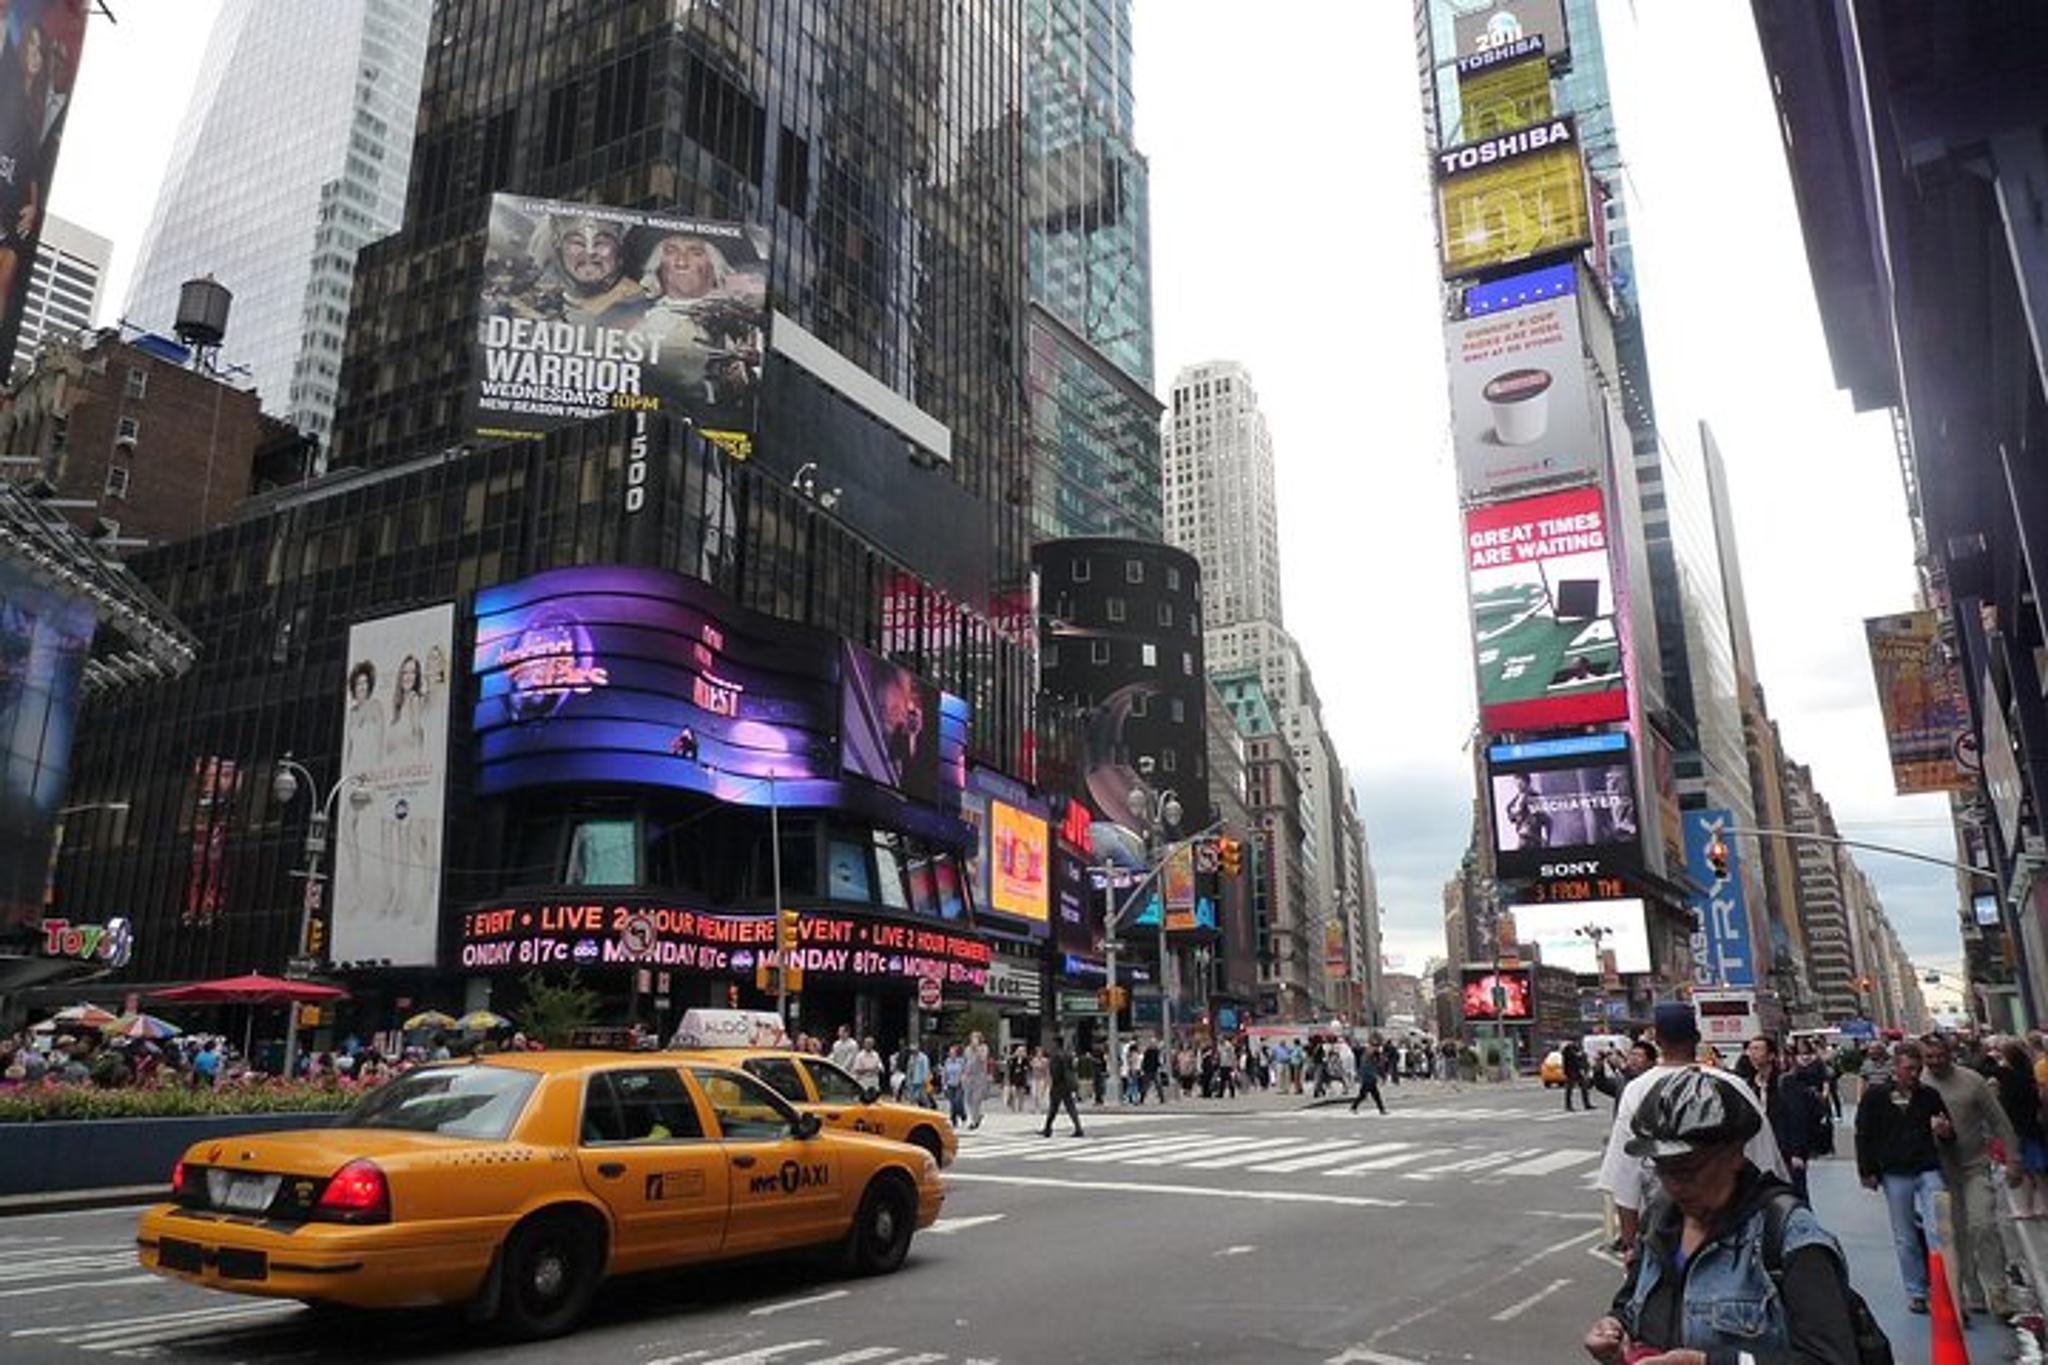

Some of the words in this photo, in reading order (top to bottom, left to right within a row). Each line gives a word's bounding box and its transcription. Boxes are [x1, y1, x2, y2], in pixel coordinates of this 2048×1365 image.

[1459, 35, 1542, 72] TOSHIBA
[1441, 121, 1570, 172] TOSHIBA
[486, 316, 666, 365] DEADLIEST
[486, 349, 641, 395] WARRIOR
[479, 398, 509, 411] NEW
[512, 401, 564, 416] SEASON
[480, 380, 608, 407] WEDNESDAYS
[612, 394, 658, 410] 10PM
[626, 412, 647, 512] 1500
[1470, 523, 1534, 548] GREAT
[1538, 513, 1601, 537] TIMES
[1473, 546, 1512, 566] ARE
[1517, 531, 1604, 558] WAITING
[1541, 861, 1599, 877] SONY
[1551, 880, 1589, 899] FROM
[541, 906, 603, 930] LIVE
[613, 906, 628, 931] 2
[873, 923, 905, 948] LIVE
[907, 929, 914, 949] 2
[780, 1160, 829, 1193] TAXI
